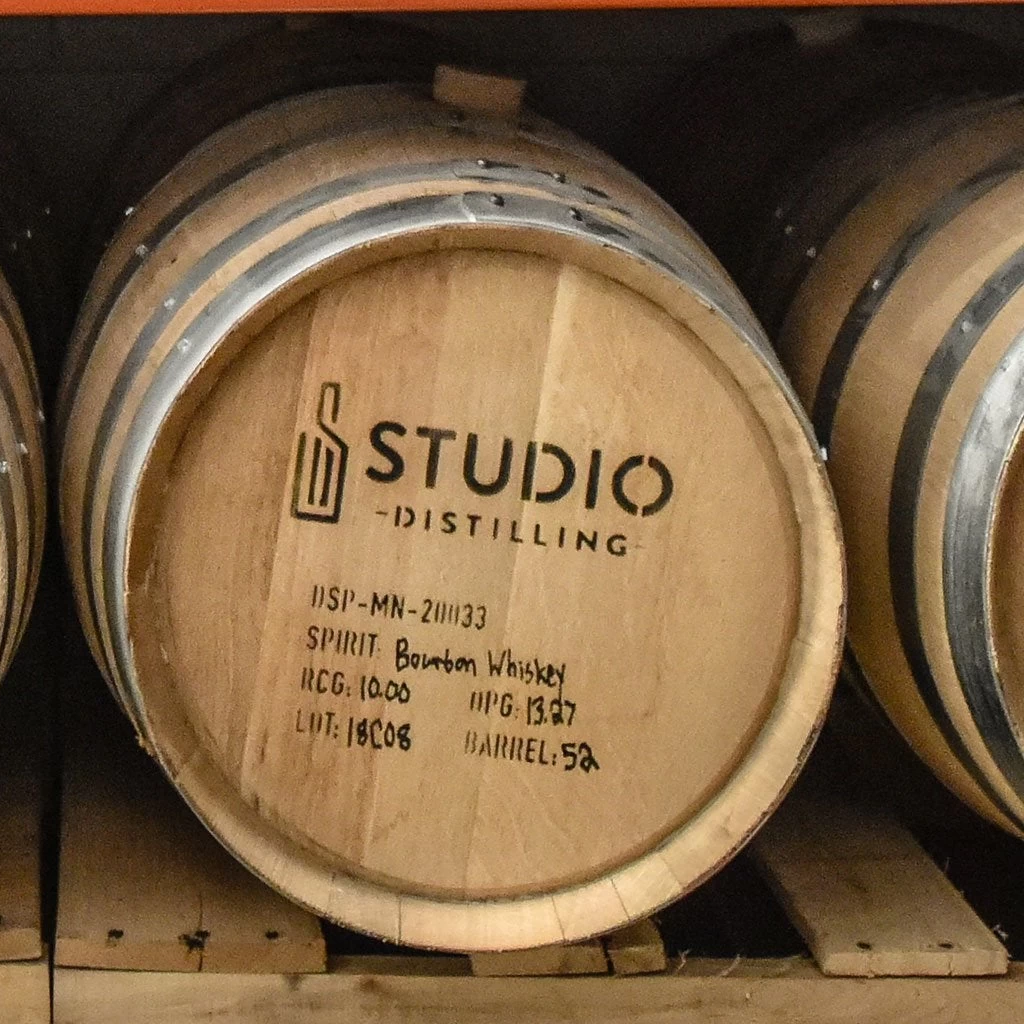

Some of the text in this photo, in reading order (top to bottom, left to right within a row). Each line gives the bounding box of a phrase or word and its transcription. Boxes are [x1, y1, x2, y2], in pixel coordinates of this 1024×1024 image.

[365, 420, 674, 517] STUDIO
[300, 667, 351, 697] RCG:
[395, 637, 476, 676] Bourbon
[487, 648, 566, 703] Whiskey
[347, 716, 412, 751] 18C08
[464, 729, 600, 774] BARREL: 52
